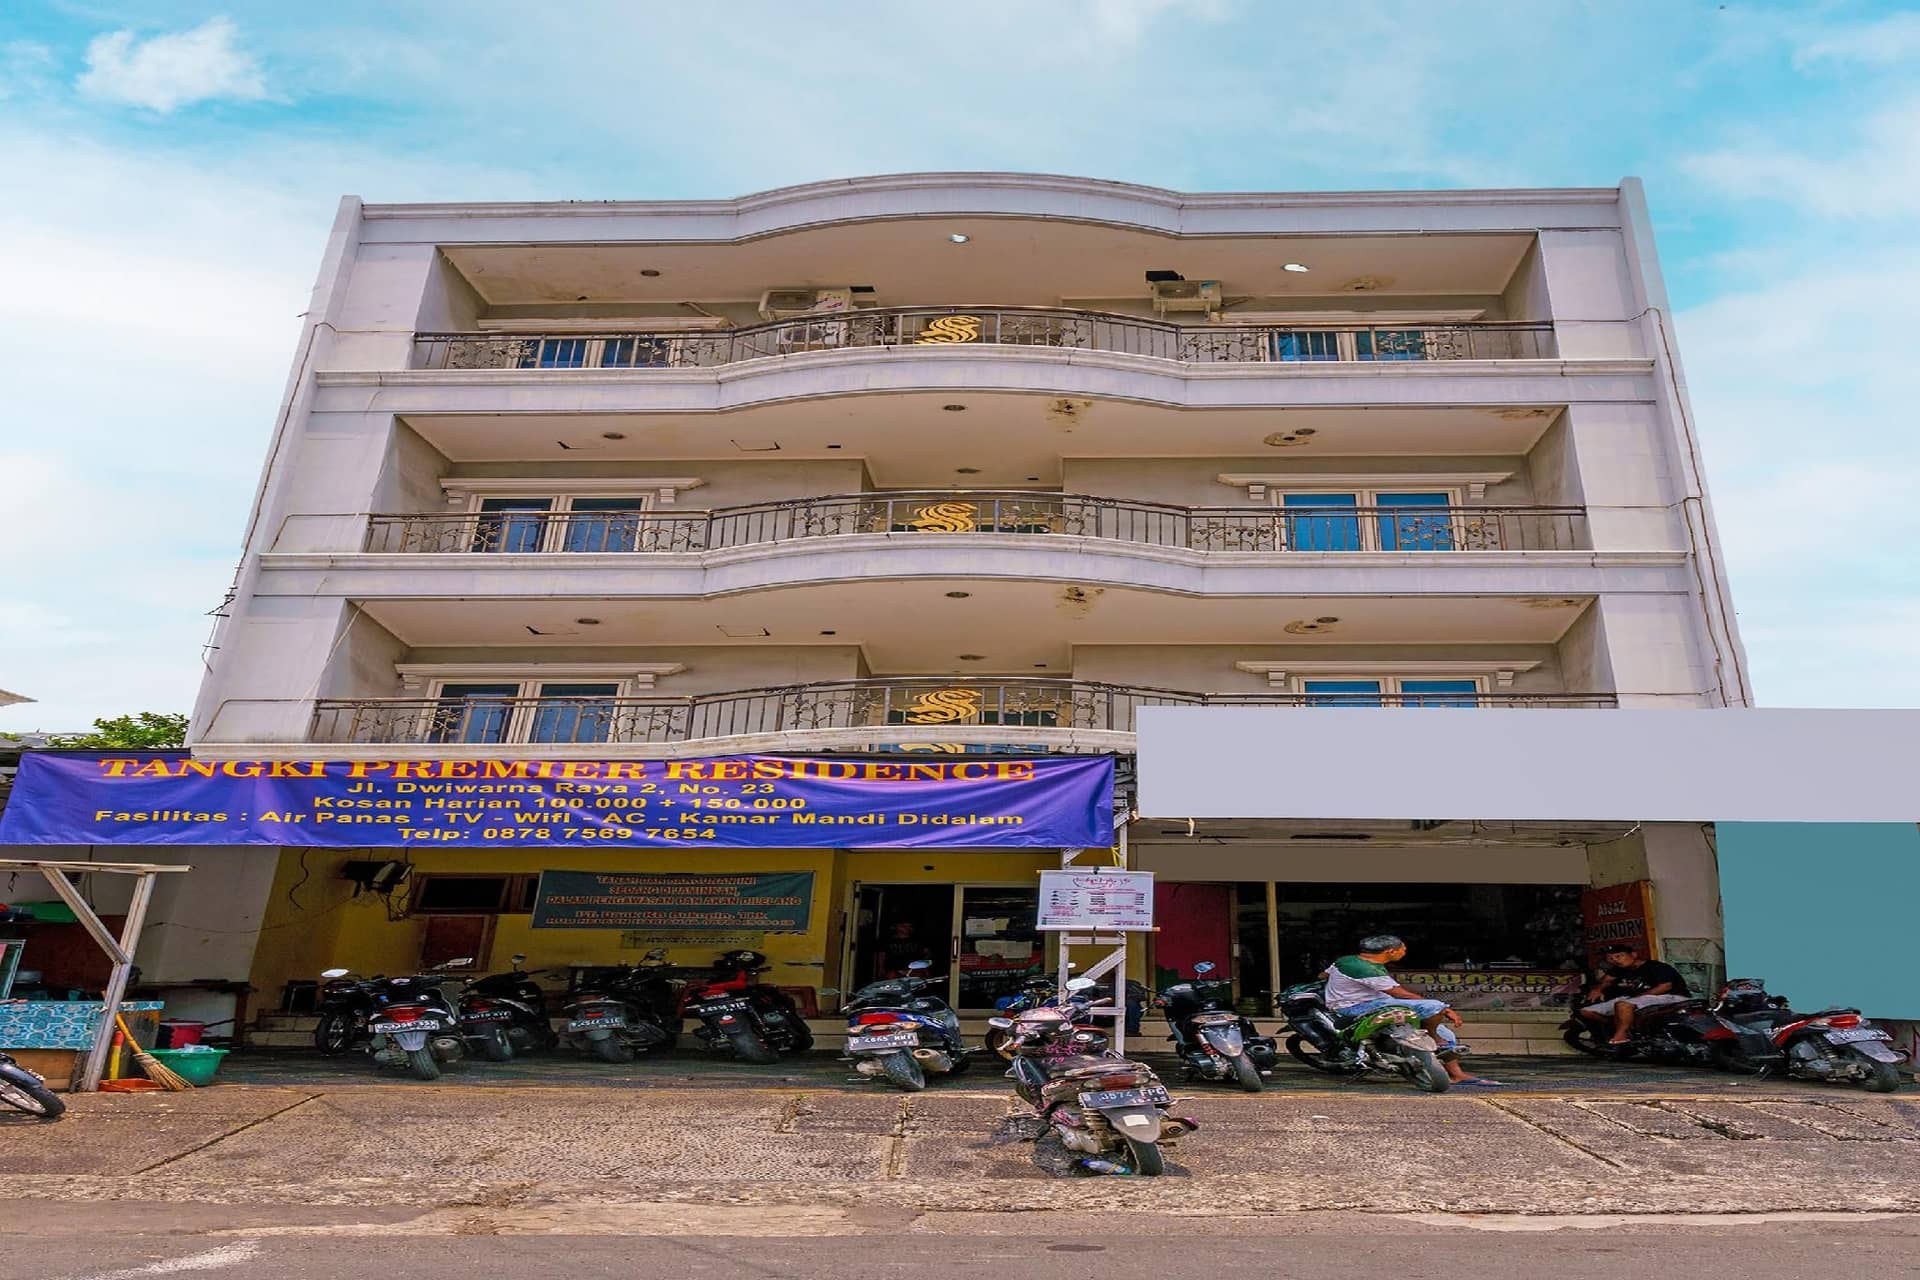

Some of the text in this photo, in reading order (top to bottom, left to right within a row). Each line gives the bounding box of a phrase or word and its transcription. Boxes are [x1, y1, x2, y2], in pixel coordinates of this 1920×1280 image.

[98, 758, 1036, 781] TANGKI PREMIER RESIDENCE
[347, 782, 383, 793] Jl.
[396, 782, 544, 793] Dwiwarna
[555, 782, 628, 795] Raya
[678, 783, 729, 794] No.
[740, 783, 775, 794] 23
[313, 796, 412, 809] Kosan
[424, 797, 521, 809] Harian
[534, 797, 648, 809] 100.000
[690, 798, 806, 809] 150.000
[95, 810, 229, 822] Fasilitas
[258, 811, 307, 823] Air
[315, 812, 411, 823] Panas
[444, 812, 485, 823] TV
[603, 812, 646, 824] AC
[679, 812, 781, 824] Kamar
[792, 813, 885, 825] Mandi
[898, 813, 1024, 825] Didalam
[397, 828, 717, 841] Telp: 0878 7569 7654
